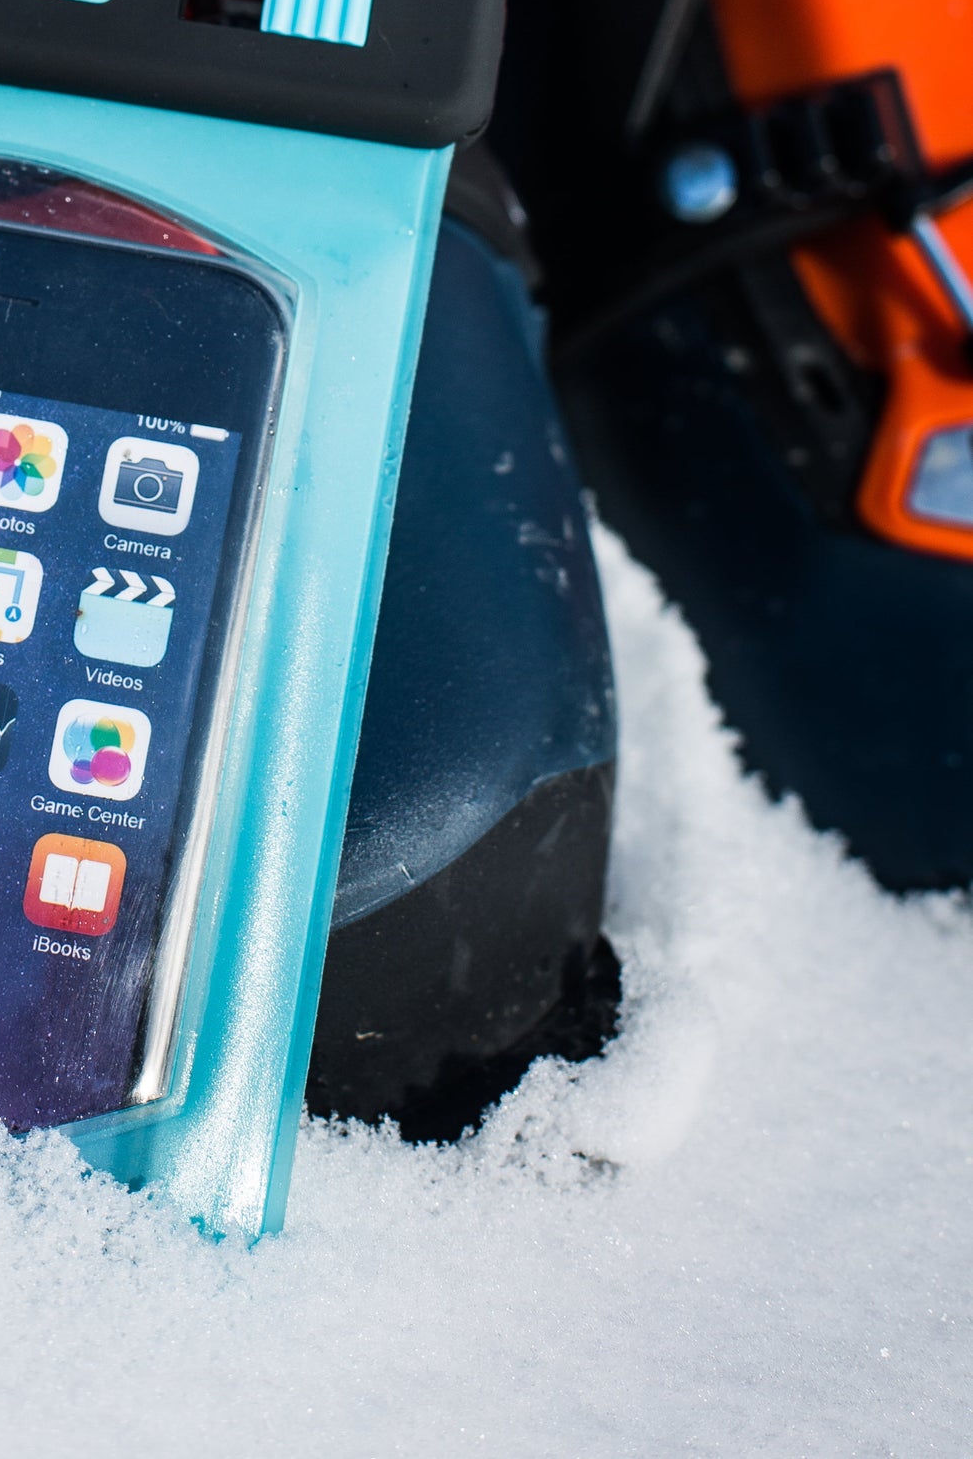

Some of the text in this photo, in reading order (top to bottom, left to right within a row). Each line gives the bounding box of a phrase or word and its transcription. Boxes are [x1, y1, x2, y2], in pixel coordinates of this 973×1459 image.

[103, 533, 172, 560] Camera
[85, 666, 143, 691] Videos
[30, 794, 146, 830] Game Center
[32, 935, 91, 961] iBooks
